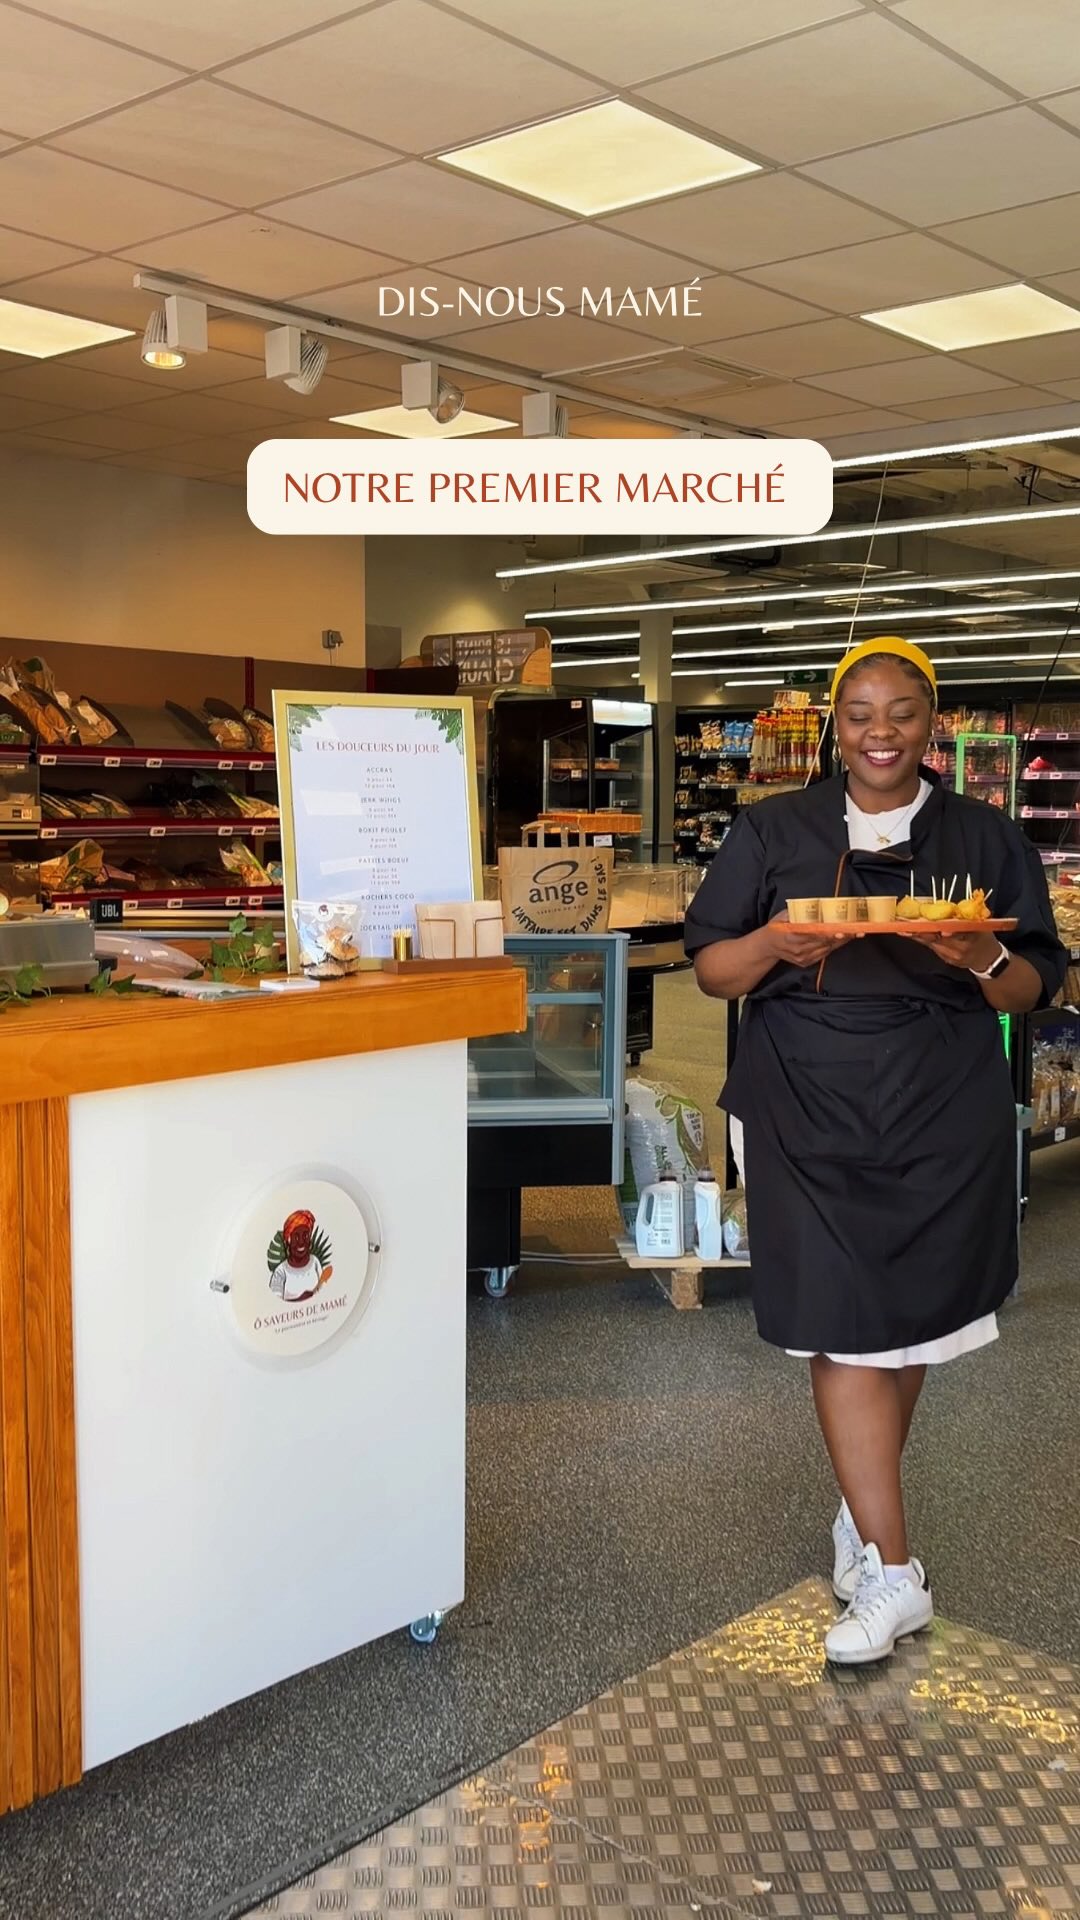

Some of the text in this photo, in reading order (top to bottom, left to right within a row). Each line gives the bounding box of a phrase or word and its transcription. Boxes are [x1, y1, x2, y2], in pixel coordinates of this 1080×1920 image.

[316, 741, 440, 756] LES DOUCEURS DU JOUR
[594, 863, 607, 884] SAC
[529, 880, 589, 906] ange
[596, 887, 608, 901] LE
[101, 903, 119, 918] JBL
[579, 903, 604, 932] DANS
[253, 1316, 262, 1330] Ô
[263, 1308, 305, 1327] SAVEURS
[306, 1304, 318, 1317] DE
[320, 1294, 348, 1312] MAMÉ
